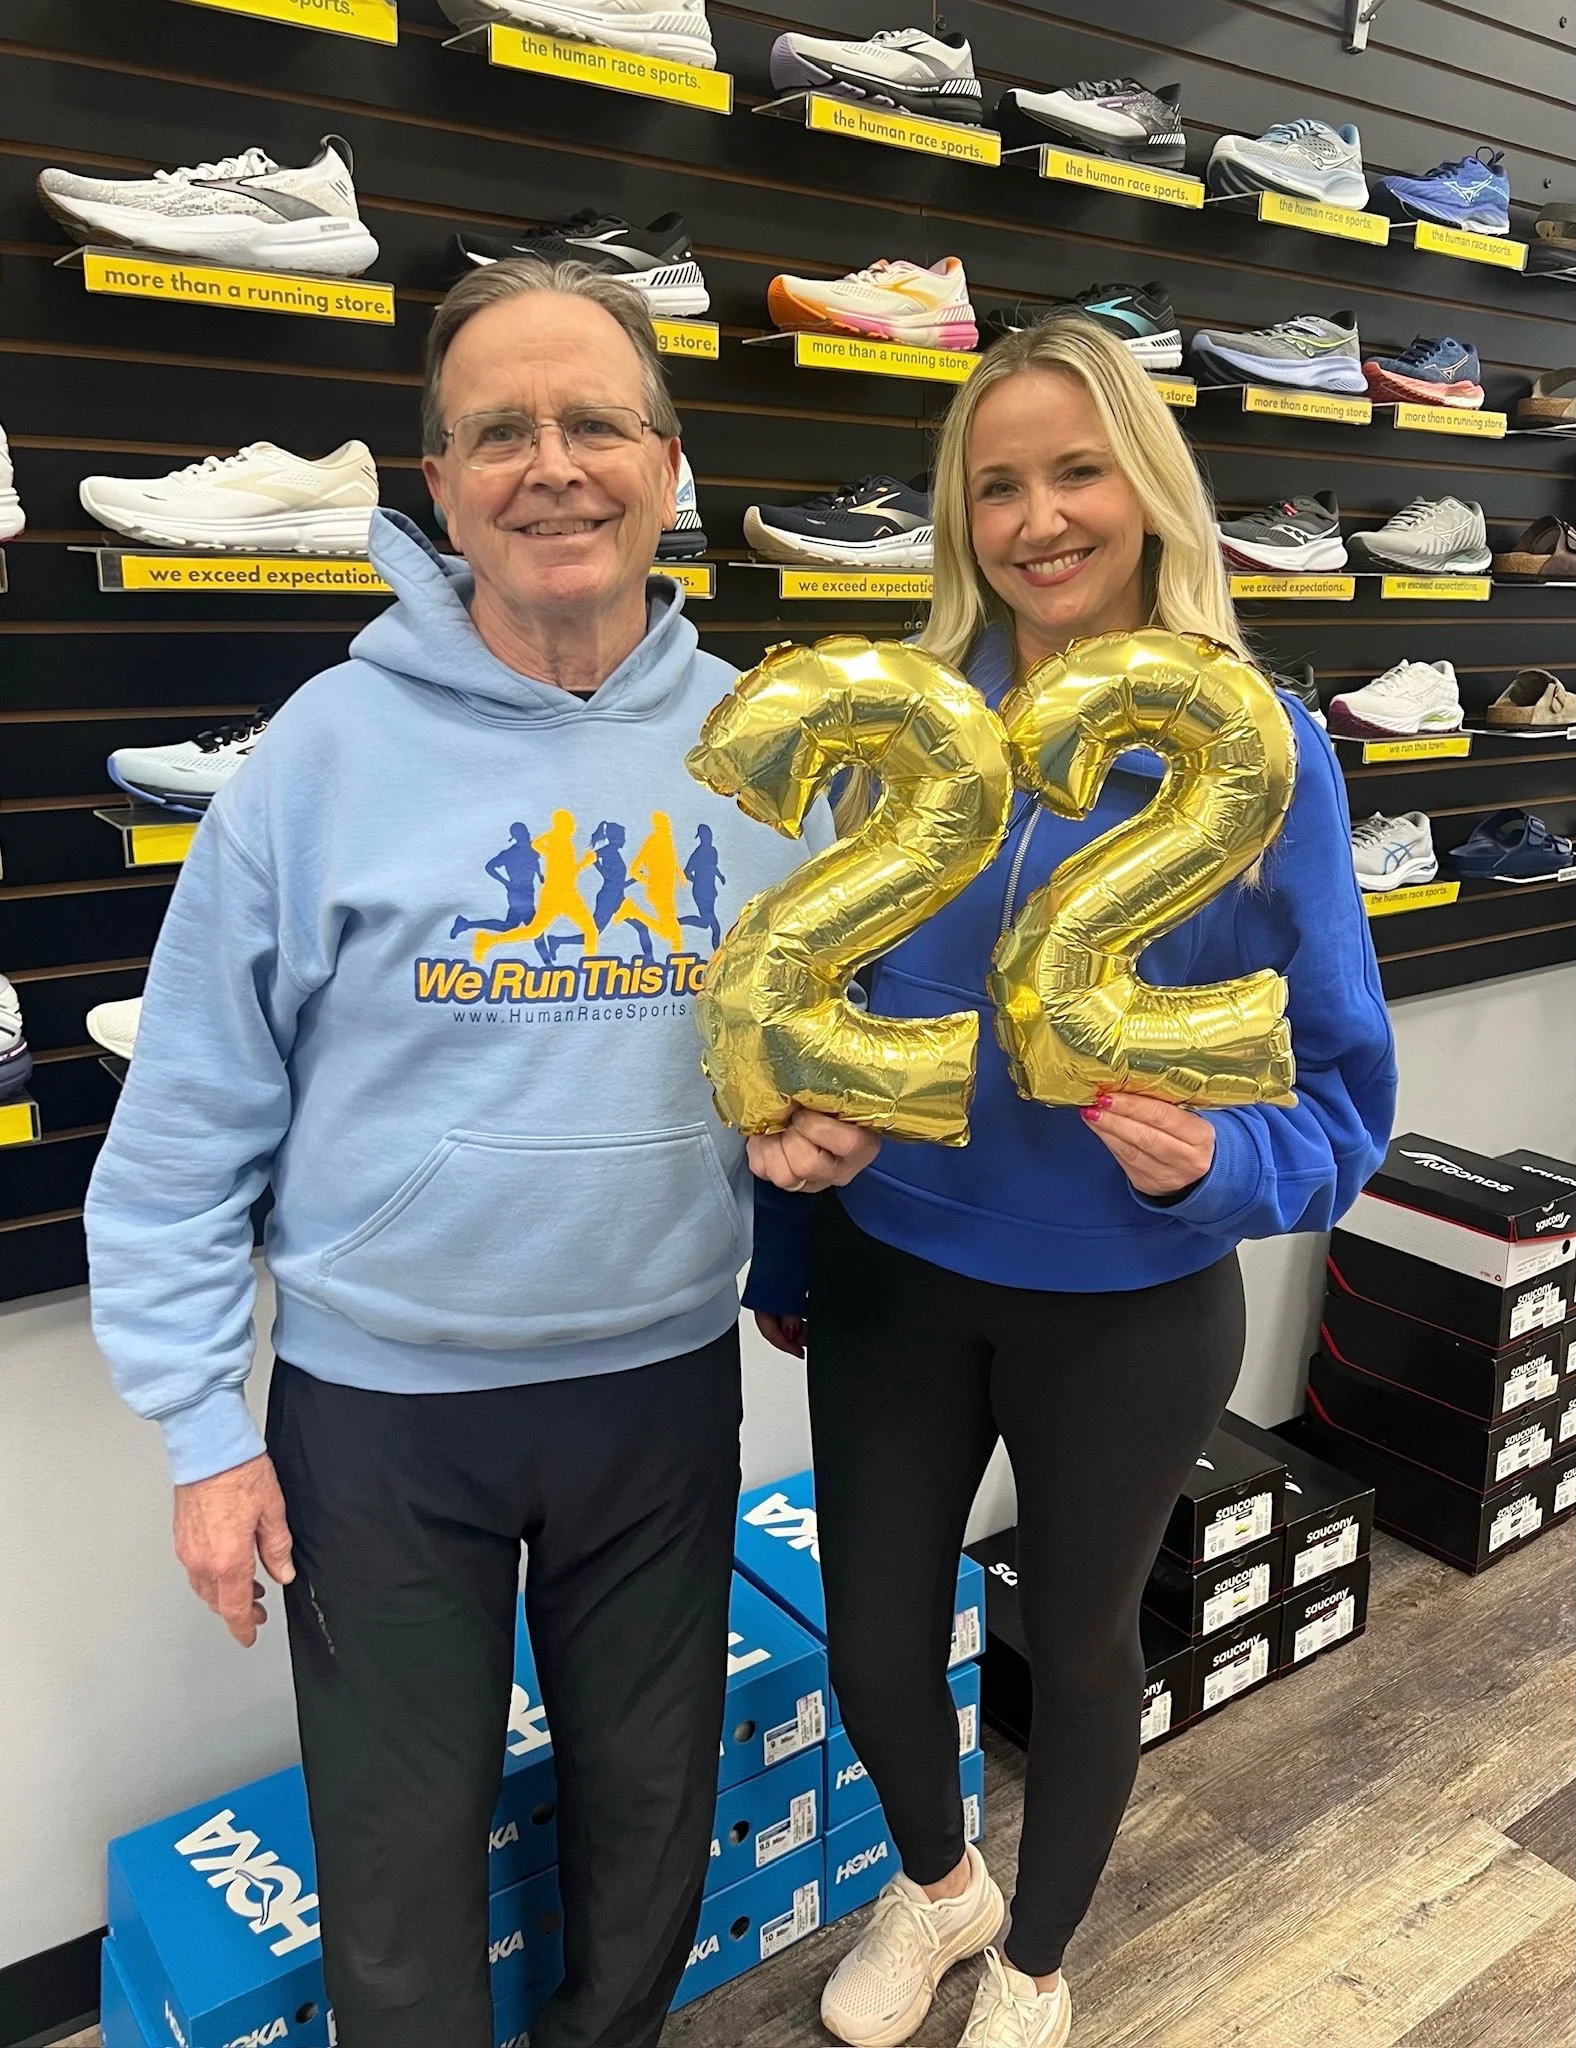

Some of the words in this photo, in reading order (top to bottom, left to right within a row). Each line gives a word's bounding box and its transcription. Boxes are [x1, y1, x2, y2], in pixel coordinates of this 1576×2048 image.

[289, 0, 355, 16] ports.
[521, 36, 547, 56] the
[552, 43, 607, 69] human
[611, 59, 646, 77] race
[650, 67, 701, 89] sports.
[833, 109, 855, 128] the
[859, 113, 906, 141] human
[909, 131, 938, 148] race
[941, 140, 984, 159] sports.
[1065, 160, 1083, 177] the
[1086, 163, 1125, 187] human
[1127, 178, 1151, 192] race
[1153, 184, 1189, 201] sports.
[1279, 197, 1293, 213] the
[1294, 201, 1324, 219] human
[1325, 211, 1344, 223] race
[1345, 215, 1372, 229] sports.
[1431, 230, 1444, 242] the
[1445, 231, 1471, 247] human
[1472, 240, 1488, 251] race
[1489, 243, 1512, 256] sports.
[104, 267, 164, 289] more
[170, 271, 221, 297] than
[228, 285, 241, 298] a
[248, 287, 329, 312] running
[335, 294, 391, 315] store.
[673, 333, 717, 352] store.
[812, 341, 845, 355] more
[849, 343, 876, 361] than
[880, 350, 887, 360] a
[890, 350, 936, 369] running
[939, 355, 971, 370] store.
[1166, 390, 1195, 403] store.
[1254, 397, 1278, 409] more
[1280, 397, 1300, 411] than
[1310, 403, 1344, 418] running
[1345, 406, 1371, 418] store.
[1405, 412, 1426, 423] more
[1427, 411, 1445, 424] than
[1453, 415, 1482, 429] running
[1484, 419, 1505, 429] store.
[150, 569, 182, 582] we
[188, 565, 260, 583] exceed
[267, 567, 382, 588] expectation
[798, 581, 818, 592] we
[822, 577, 867, 592] exceed
[870, 579, 934, 597] expectatio
[1240, 584, 1254, 592] we
[1256, 581, 1288, 592] exceed
[1289, 581, 1346, 595] expectations.
[1389, 744, 1400, 753] we
[1401, 743, 1414, 752] run
[1414, 741, 1427, 752] this
[1428, 741, 1448, 751] town.
[1370, 894, 1382, 904] the
[1383, 892, 1408, 903] human
[1408, 890, 1424, 899] race
[1425, 886, 1448, 898] sports.
[416, 959, 485, 1000] We
[490, 962, 578, 999] Run
[582, 957, 664, 995] This
[670, 956, 708, 991] To
[453, 1002, 693, 1023] www.HumanRaceSports.
[1414, 1159, 1515, 1193] saucony
[1535, 1211, 1565, 1233] saucony
[1517, 1281, 1554, 1306] saucony
[1510, 1353, 1547, 1380] saucony
[1504, 1421, 1541, 1448] saucony
[1305, 1515, 1354, 1544] saucony
[1304, 1586, 1350, 1619] saucony
[1212, 1632, 1262, 1668] saucony
[835, 1840, 889, 1885] HOKA
[174, 1808, 321, 1957] HOKA
